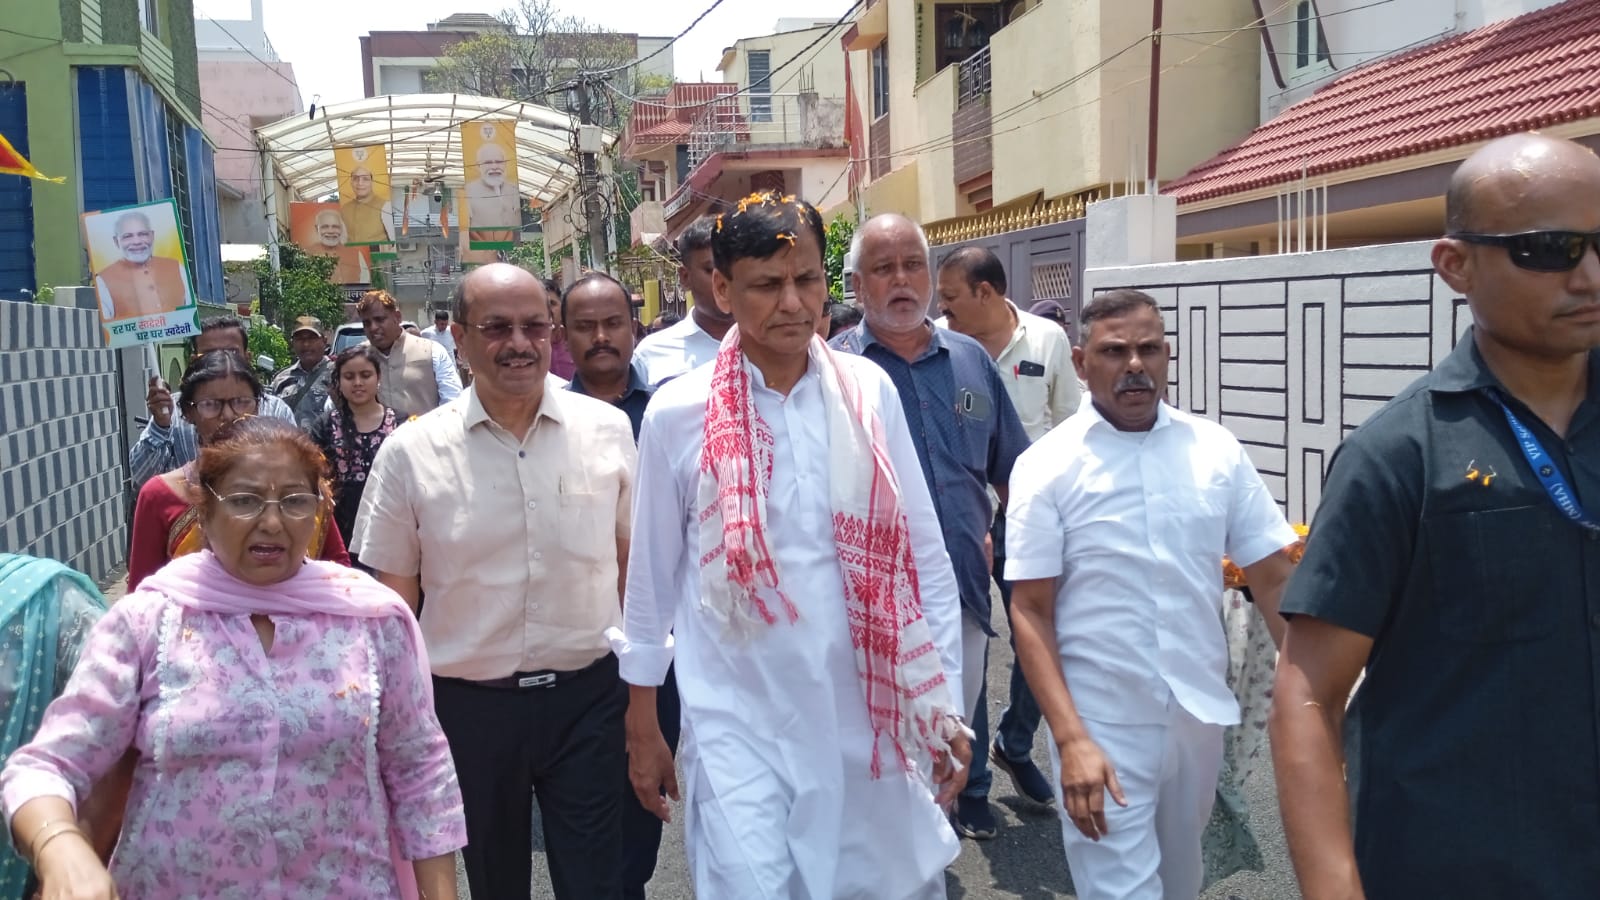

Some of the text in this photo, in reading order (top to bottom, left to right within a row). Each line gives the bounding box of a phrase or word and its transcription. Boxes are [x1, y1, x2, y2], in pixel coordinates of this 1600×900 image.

[165, 323, 191, 336] स्वदेशी
[1525, 441, 1541, 460] VIP
[1550, 482, 1581, 519] (MHA)
